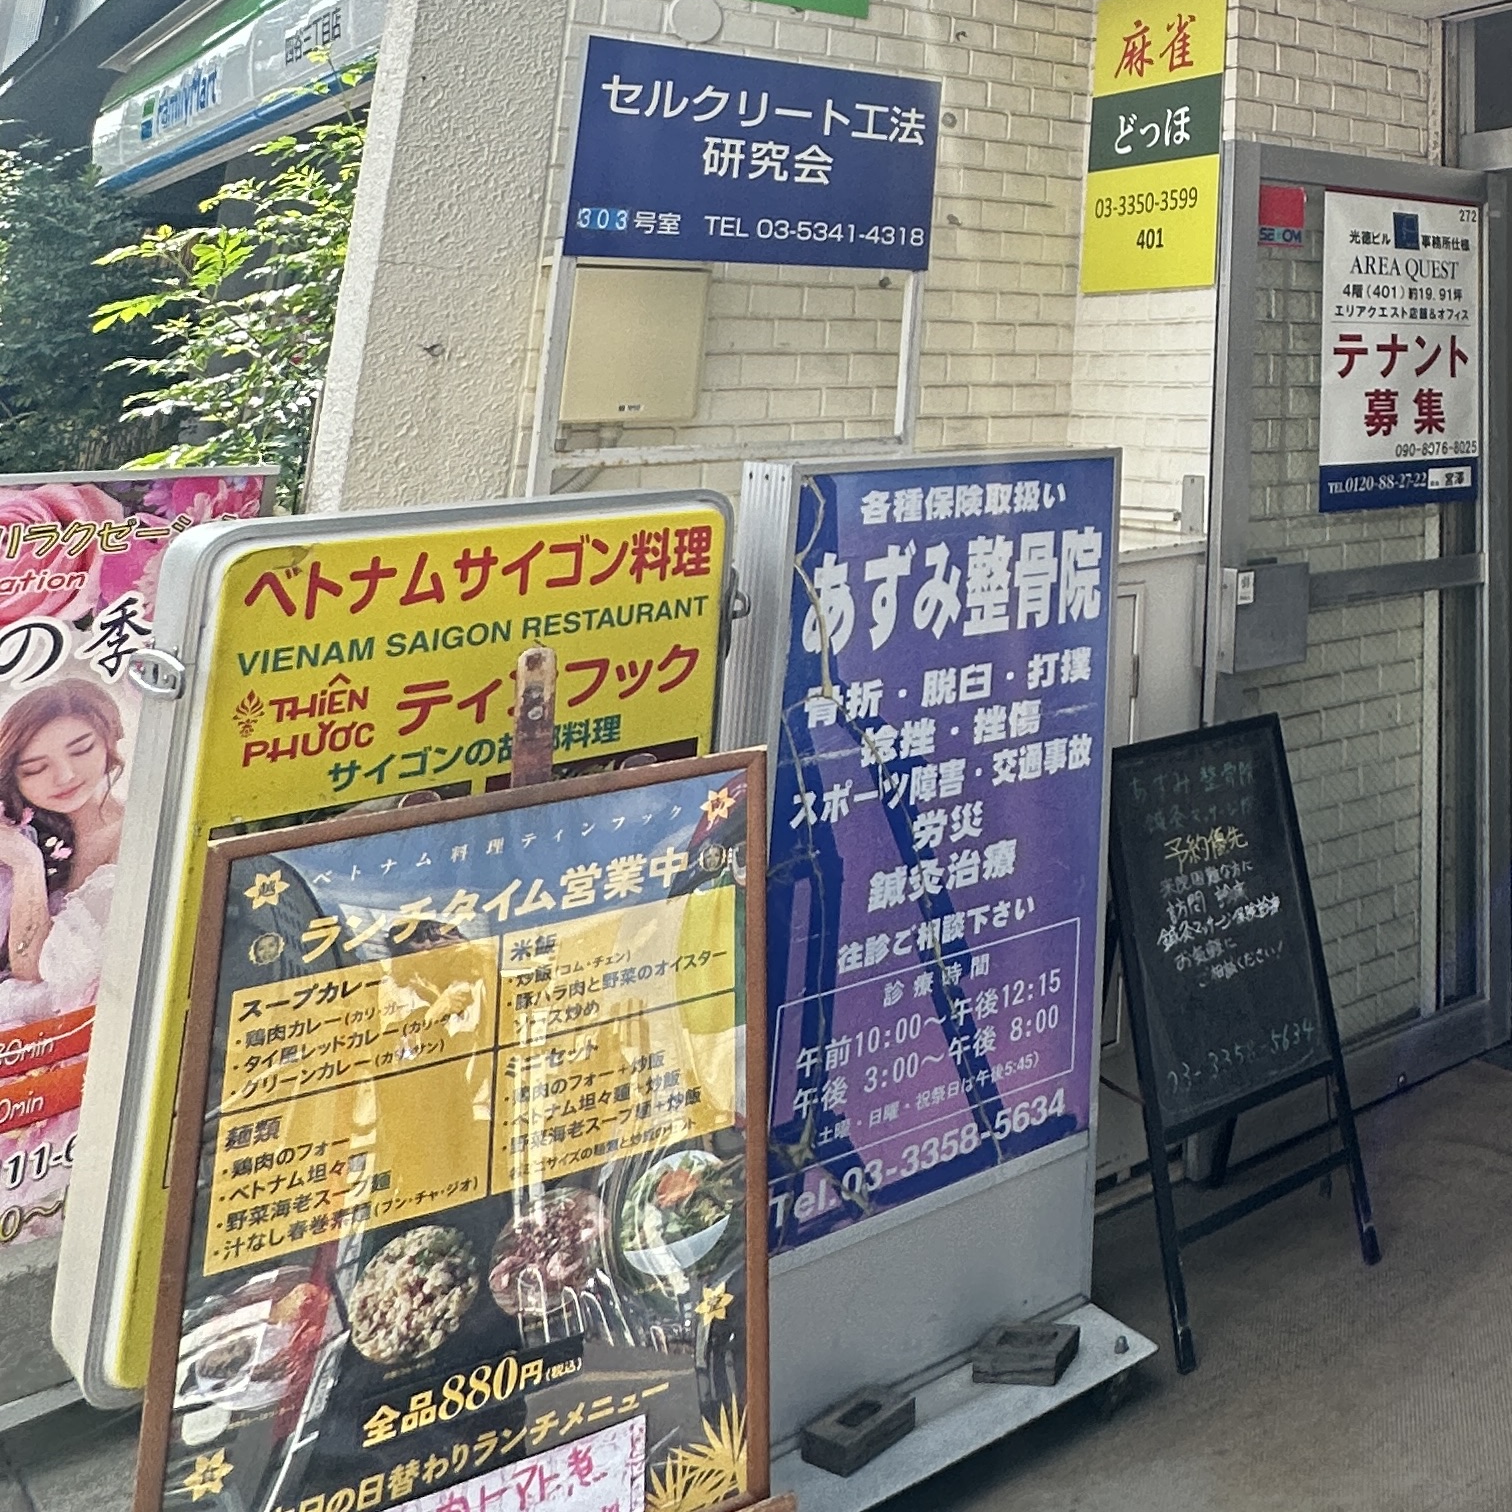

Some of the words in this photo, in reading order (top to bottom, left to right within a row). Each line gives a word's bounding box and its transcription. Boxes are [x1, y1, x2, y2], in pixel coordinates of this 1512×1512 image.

[1114, 13, 1198, 79] 麻雀
[601, 74, 927, 147] セルクリート工法
[703, 136, 834, 187] 研究会
[1094, 186, 1199, 220] 03-3350-3599
[1459, 208, 1478, 223] 272
[704, 215, 750, 240] TEL
[756, 218, 926, 247] 03-5341-4318
[1136, 227, 1165, 251] 401
[1350, 254, 1402, 277] AREA
[1404, 257, 1460, 283] QUEST
[1333, 333, 1469, 379] テナント
[1364, 388, 1446, 438] 募集
[860, 479, 1067, 525] 各種保険取扱い
[244, 525, 713, 620] ベトナムサイゴン料理
[801, 526, 1103, 656] あずみ整骨院
[237, 636, 374, 677] VIENAM
[384, 619, 513, 659] SAIGON
[521, 594, 710, 641] RESTAURANT
[912, 800, 985, 852] 労災
[1163, 825, 1249, 874] 予約優先
[866, 838, 1018, 913] 鍼灸治療
[301, 845, 690, 965] ランチタイム営業中
[510, 932, 558, 962] 米飯
[836, 895, 1036, 975] 往診ご相談下さい
[237, 978, 383, 1023] スープカレー
[883, 953, 991, 1008] 診療時間
[504, 1038, 599, 1079] ミニセット
[223, 1115, 284, 1153] 麺類
[275, 1381, 670, 1512] 日の日替わりランチメニュー
